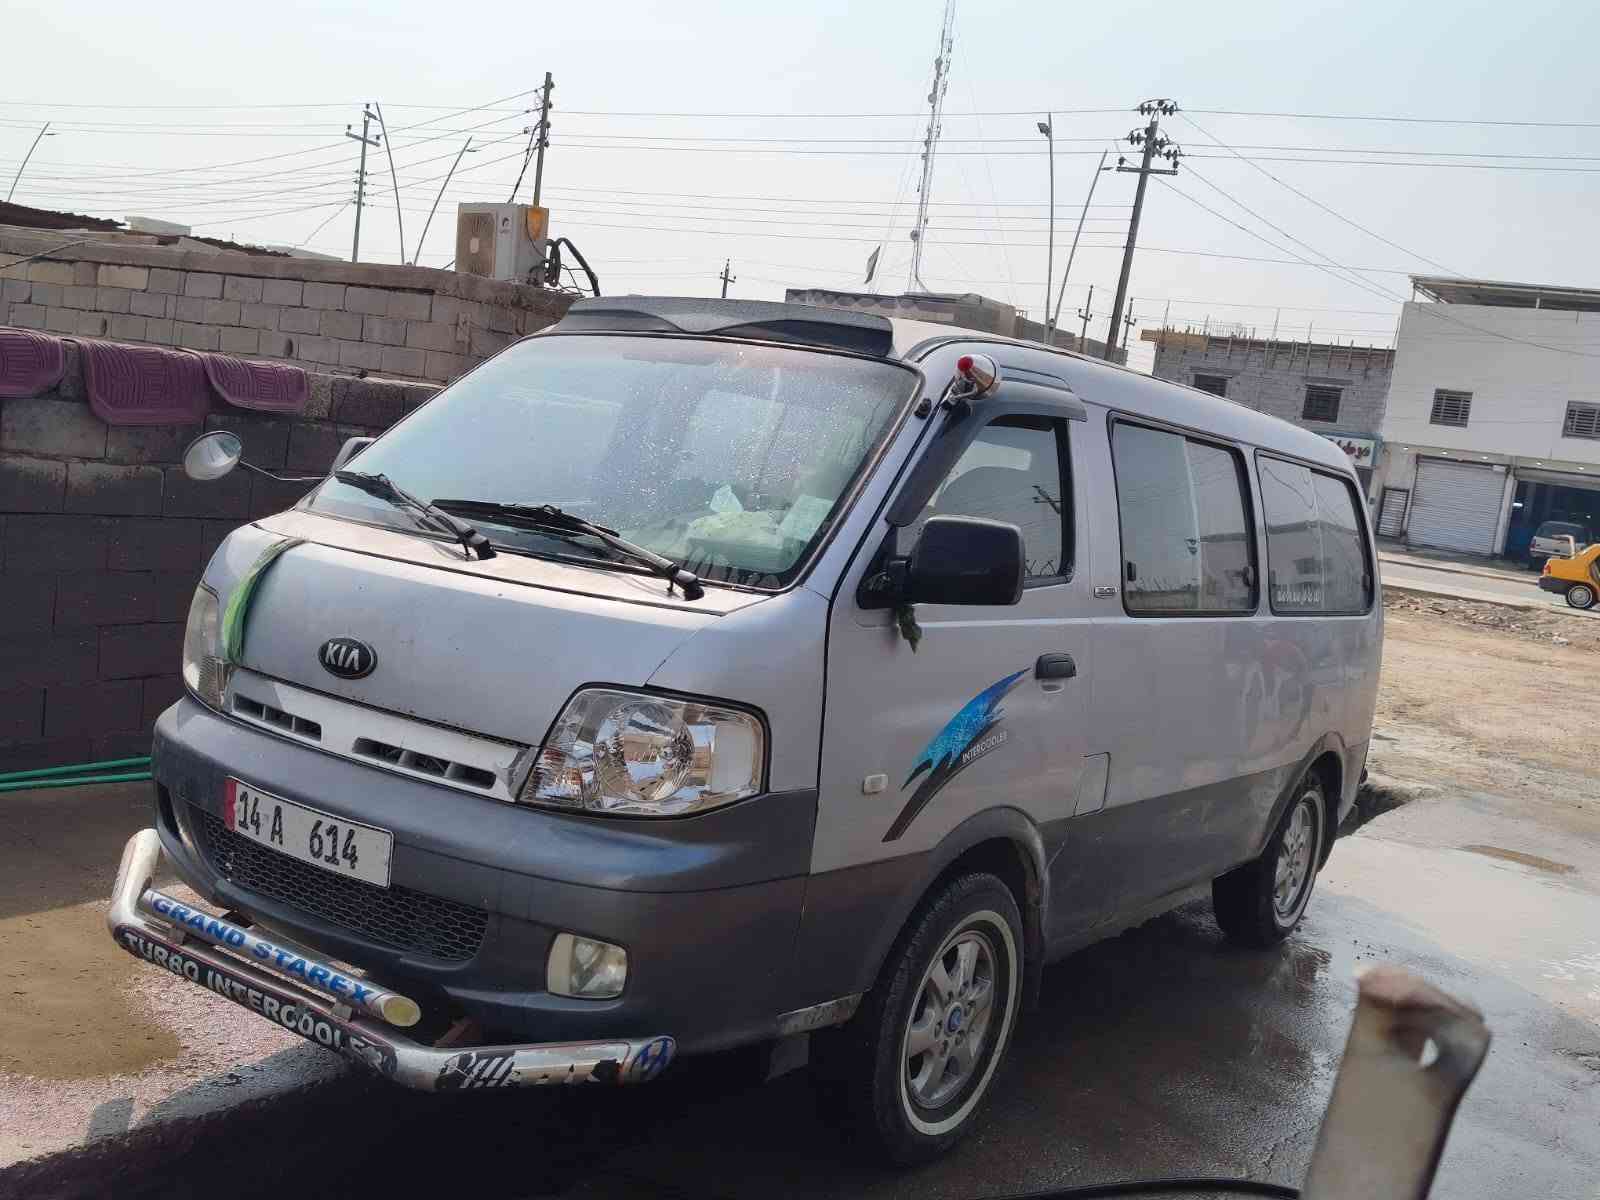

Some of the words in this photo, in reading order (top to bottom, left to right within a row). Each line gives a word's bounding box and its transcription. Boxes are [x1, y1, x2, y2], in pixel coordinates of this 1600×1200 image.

[325, 641, 360, 671] KIA
[238, 791, 260, 836] 14
[270, 805, 284, 846] A
[309, 819, 358, 870] 614
[120, 930, 200, 981] TURBO
[151, 898, 246, 949] GRAND
[252, 942, 375, 1006] STAREX
